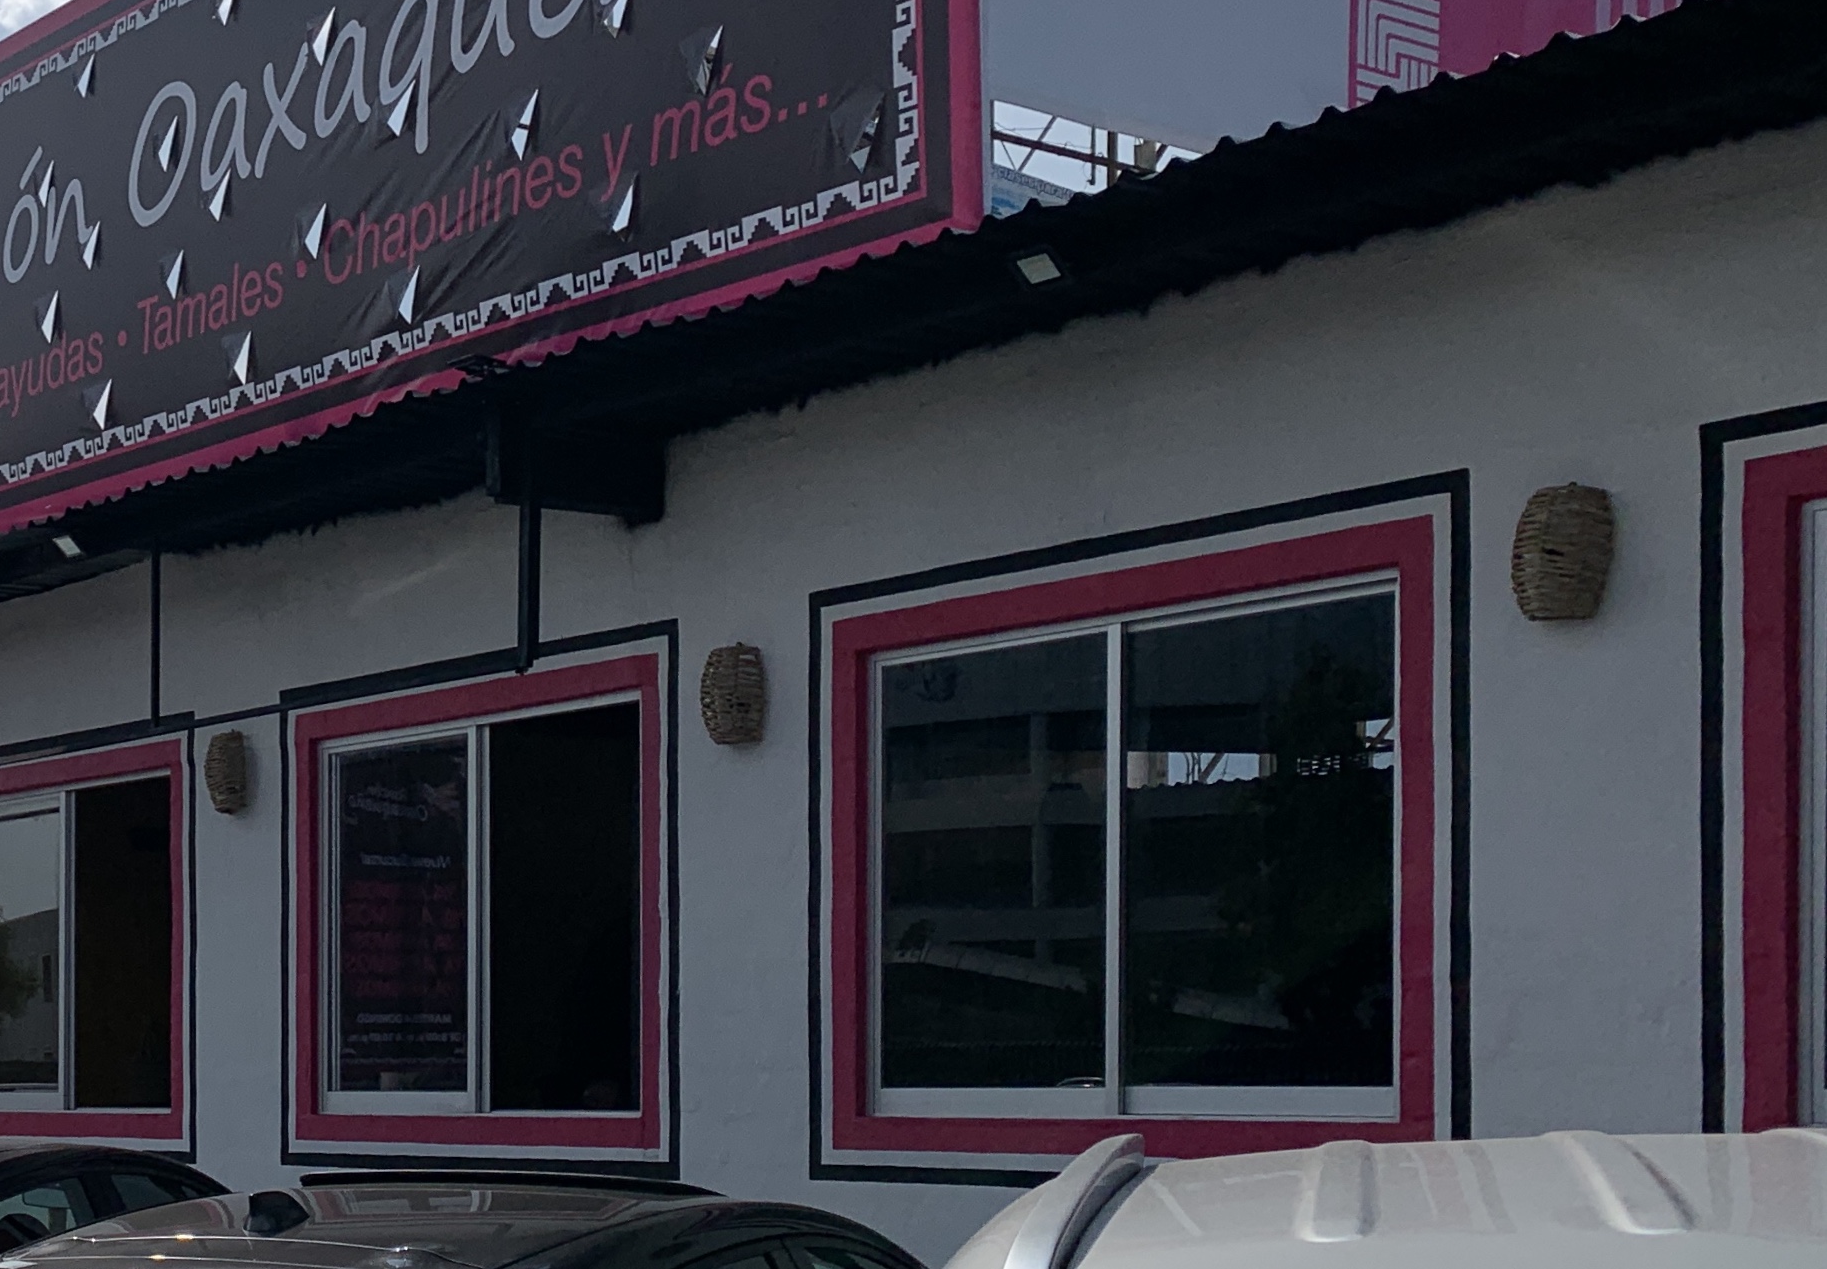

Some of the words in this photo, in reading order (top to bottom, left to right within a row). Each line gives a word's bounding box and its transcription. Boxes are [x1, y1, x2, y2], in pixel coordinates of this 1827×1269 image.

[137, 259, 284, 358] Tamales
[323, 153, 584, 287] Chapulines
[602, 123, 632, 203] y
[649, 63, 830, 167] más...
